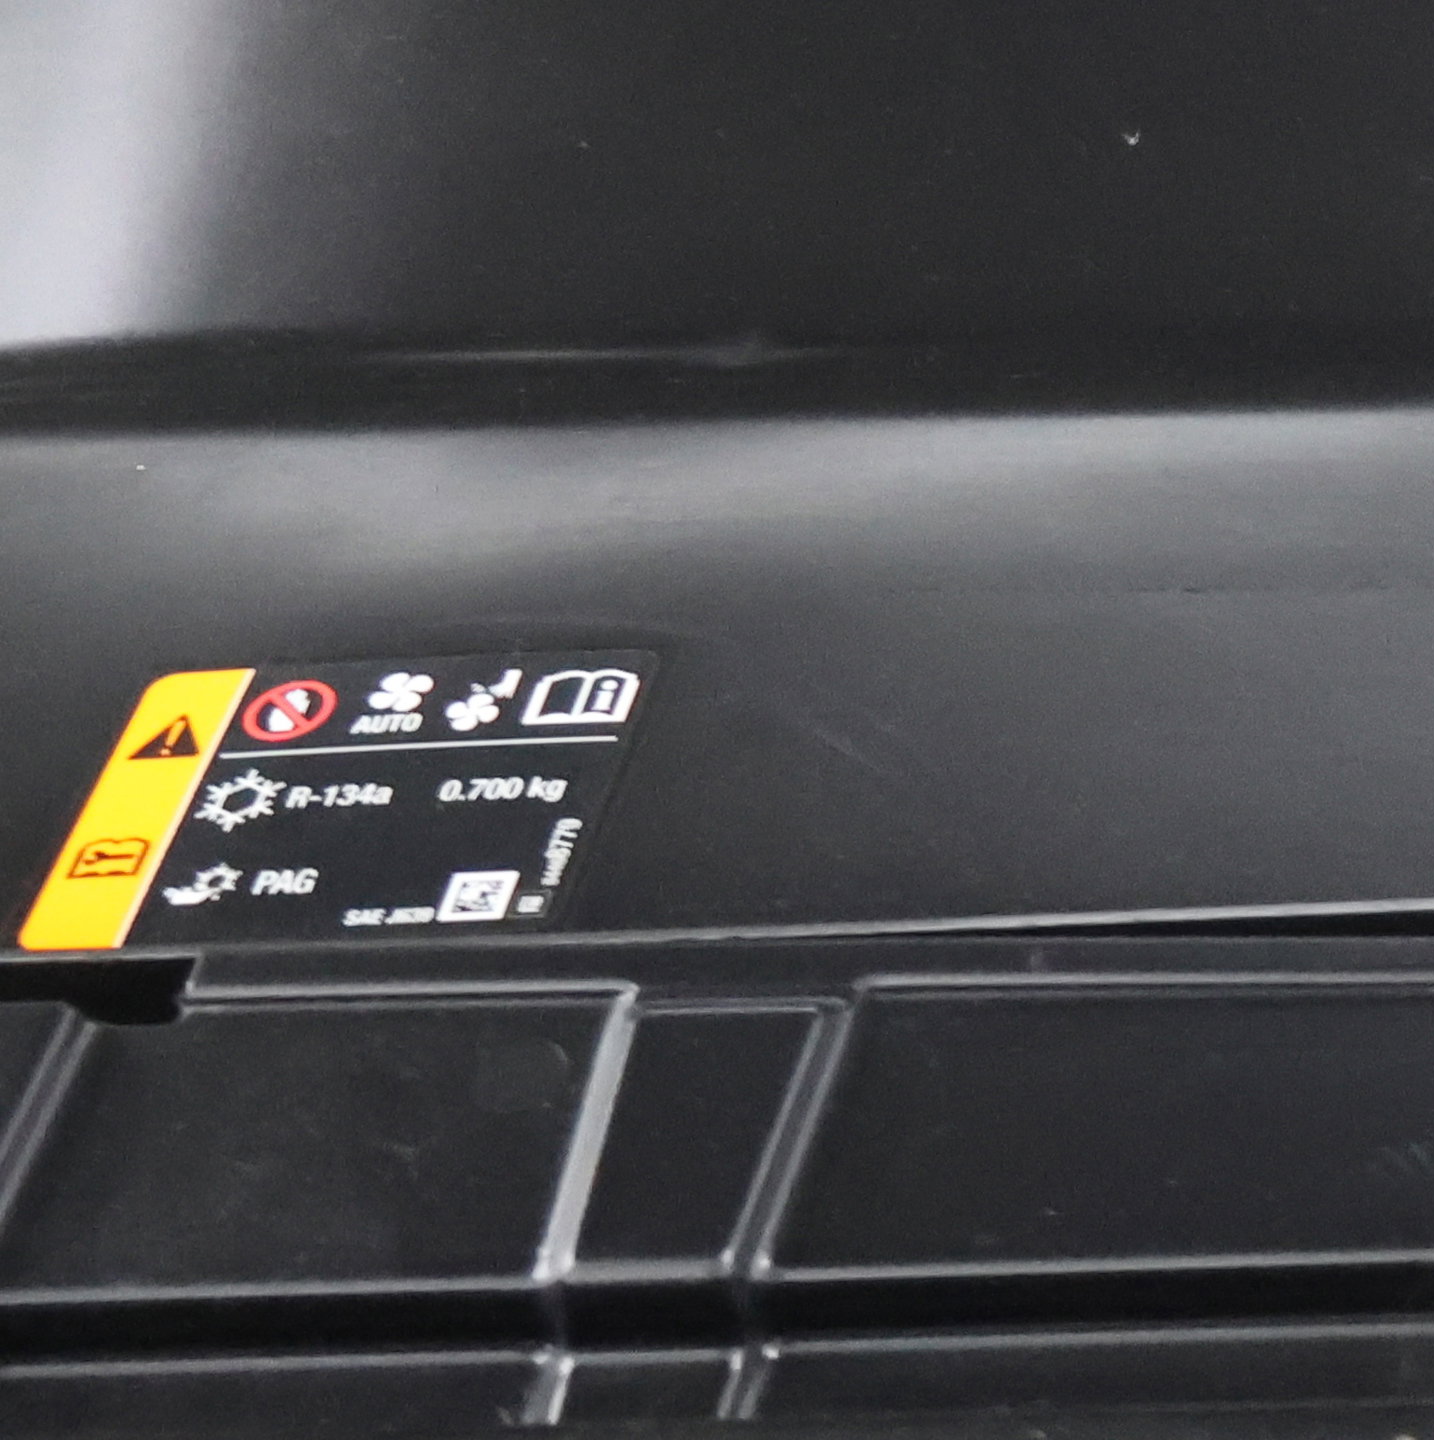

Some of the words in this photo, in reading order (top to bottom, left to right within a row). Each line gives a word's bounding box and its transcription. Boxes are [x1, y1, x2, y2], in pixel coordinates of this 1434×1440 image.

[350, 713, 424, 735] AUTO
[284, 782, 394, 809] R-134a
[437, 777, 525, 803] 0.700
[526, 776, 569, 803] kg
[251, 868, 320, 896] PAG
